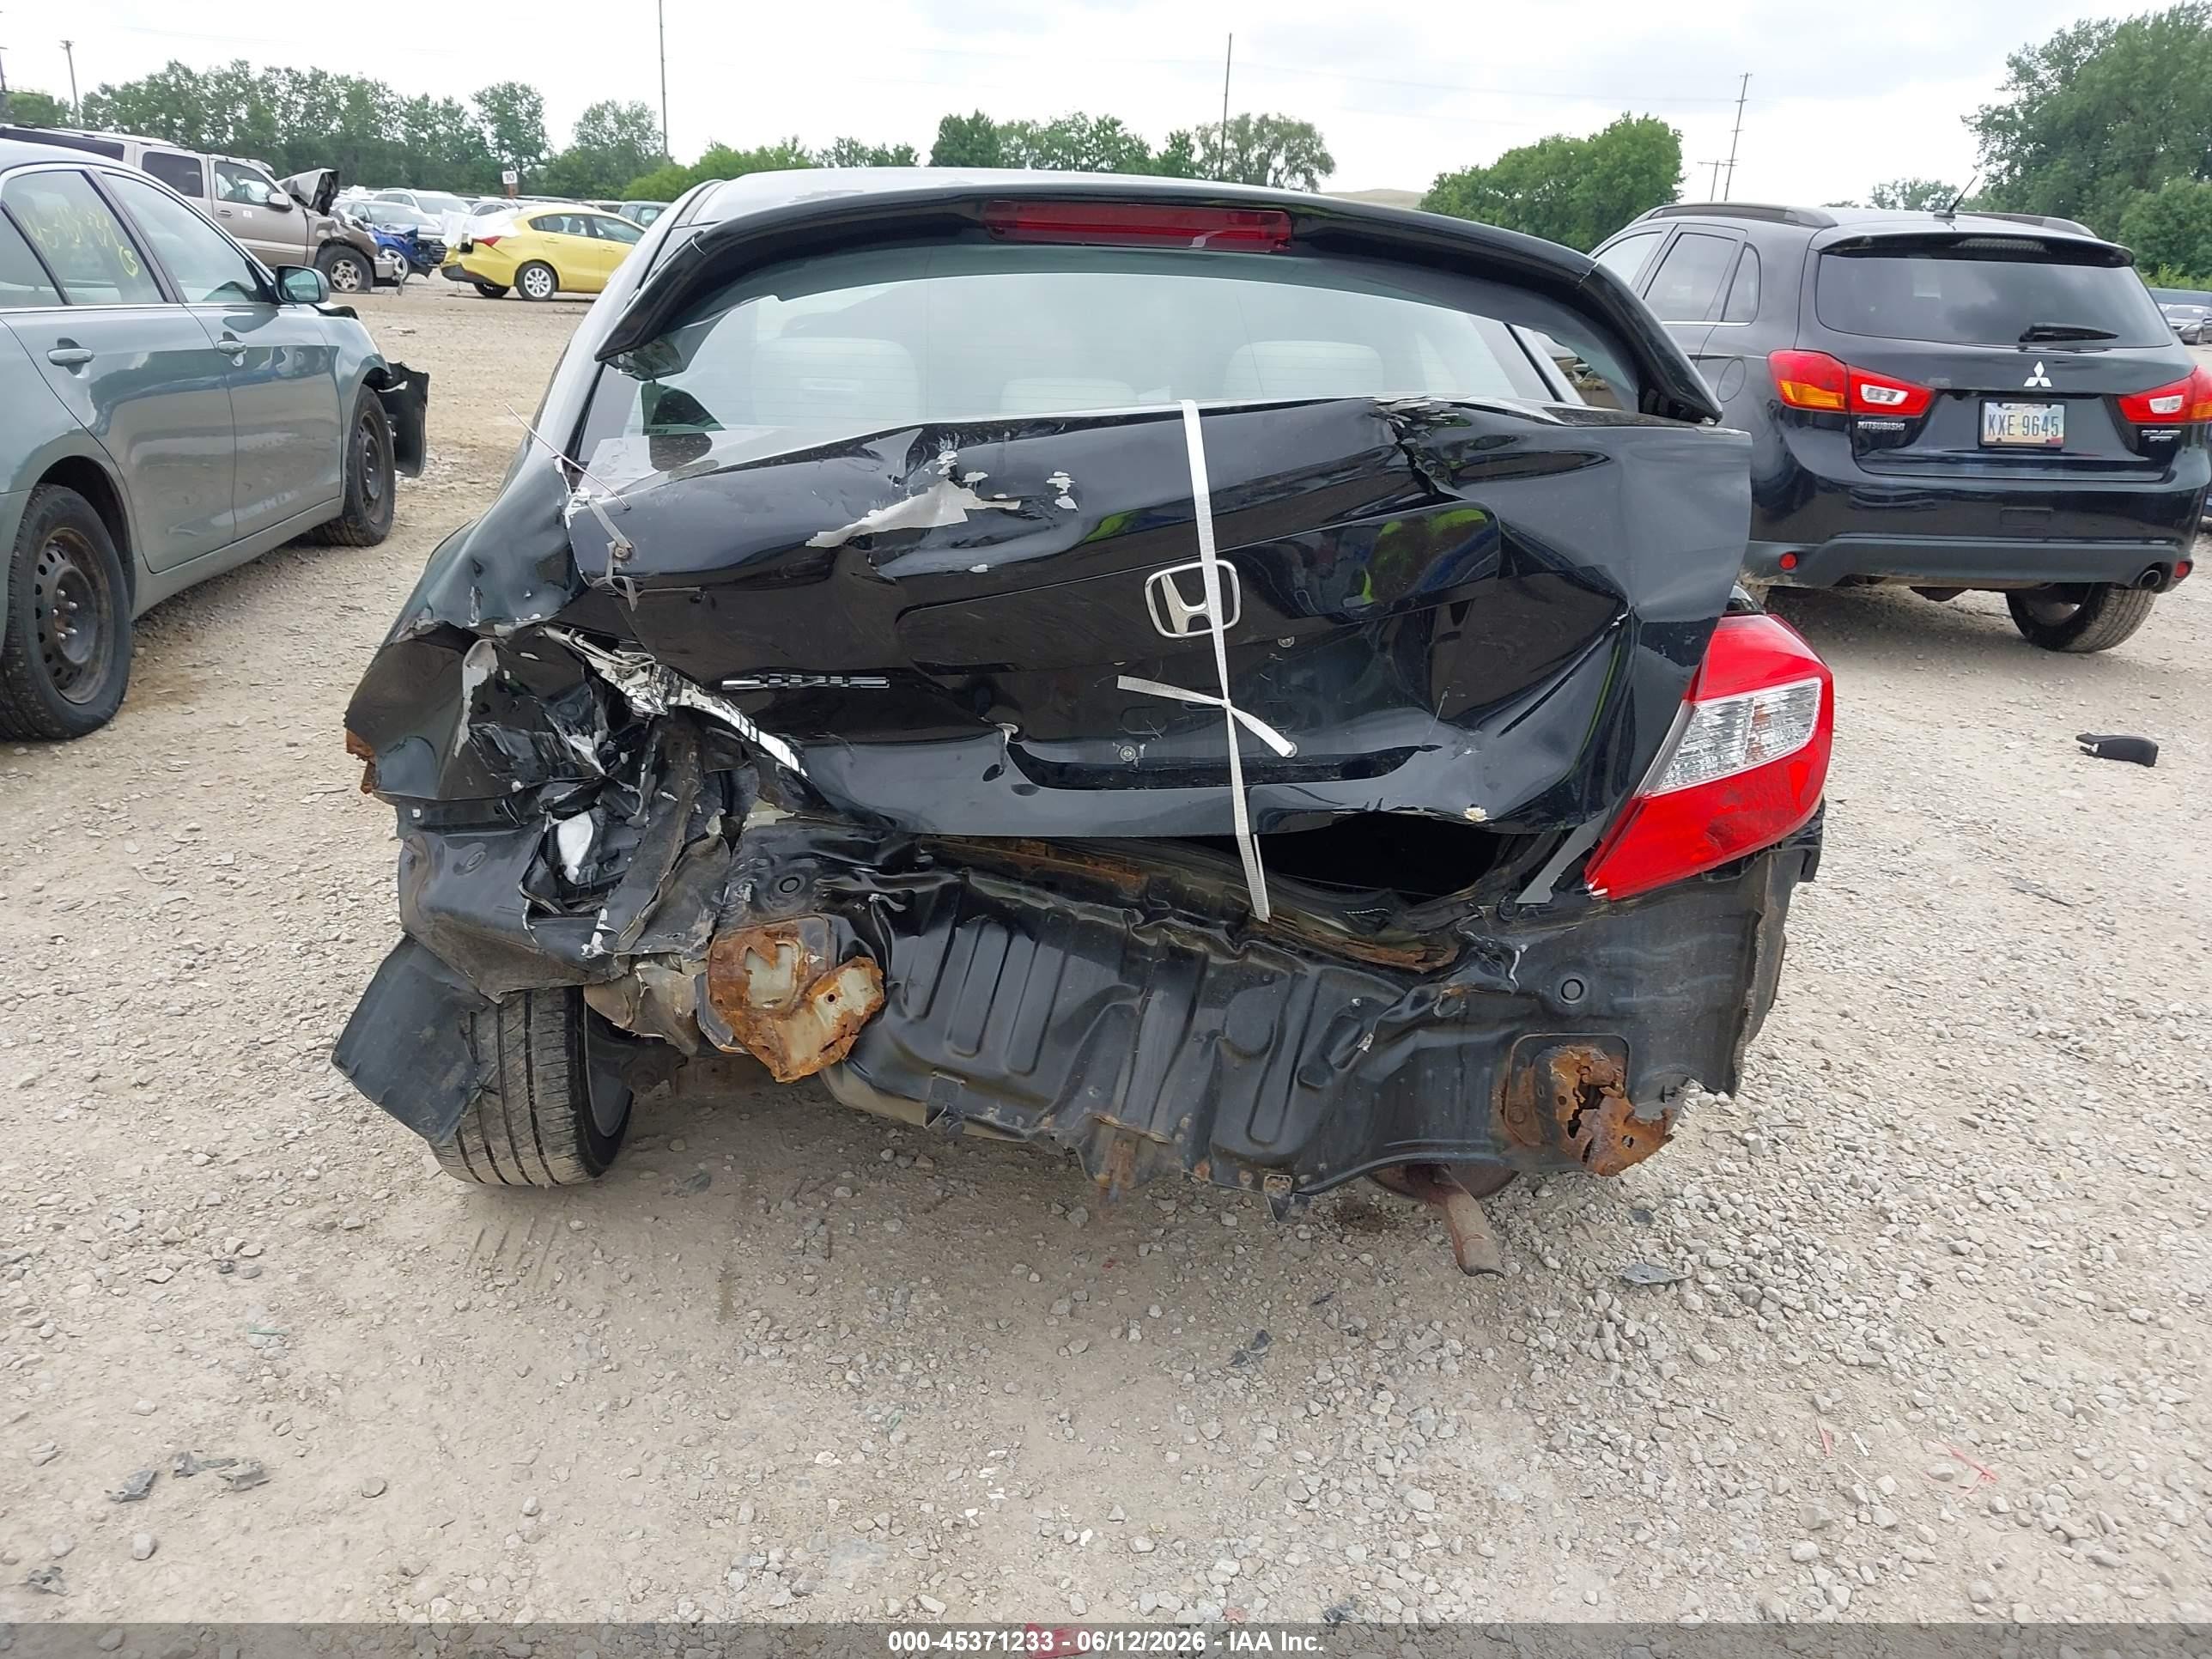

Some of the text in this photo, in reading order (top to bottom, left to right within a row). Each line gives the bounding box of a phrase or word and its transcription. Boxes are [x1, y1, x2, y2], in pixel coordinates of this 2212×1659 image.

[1856, 421, 1905, 431] MITSUBISHI
[1988, 414, 2058, 437] KXE 9645
